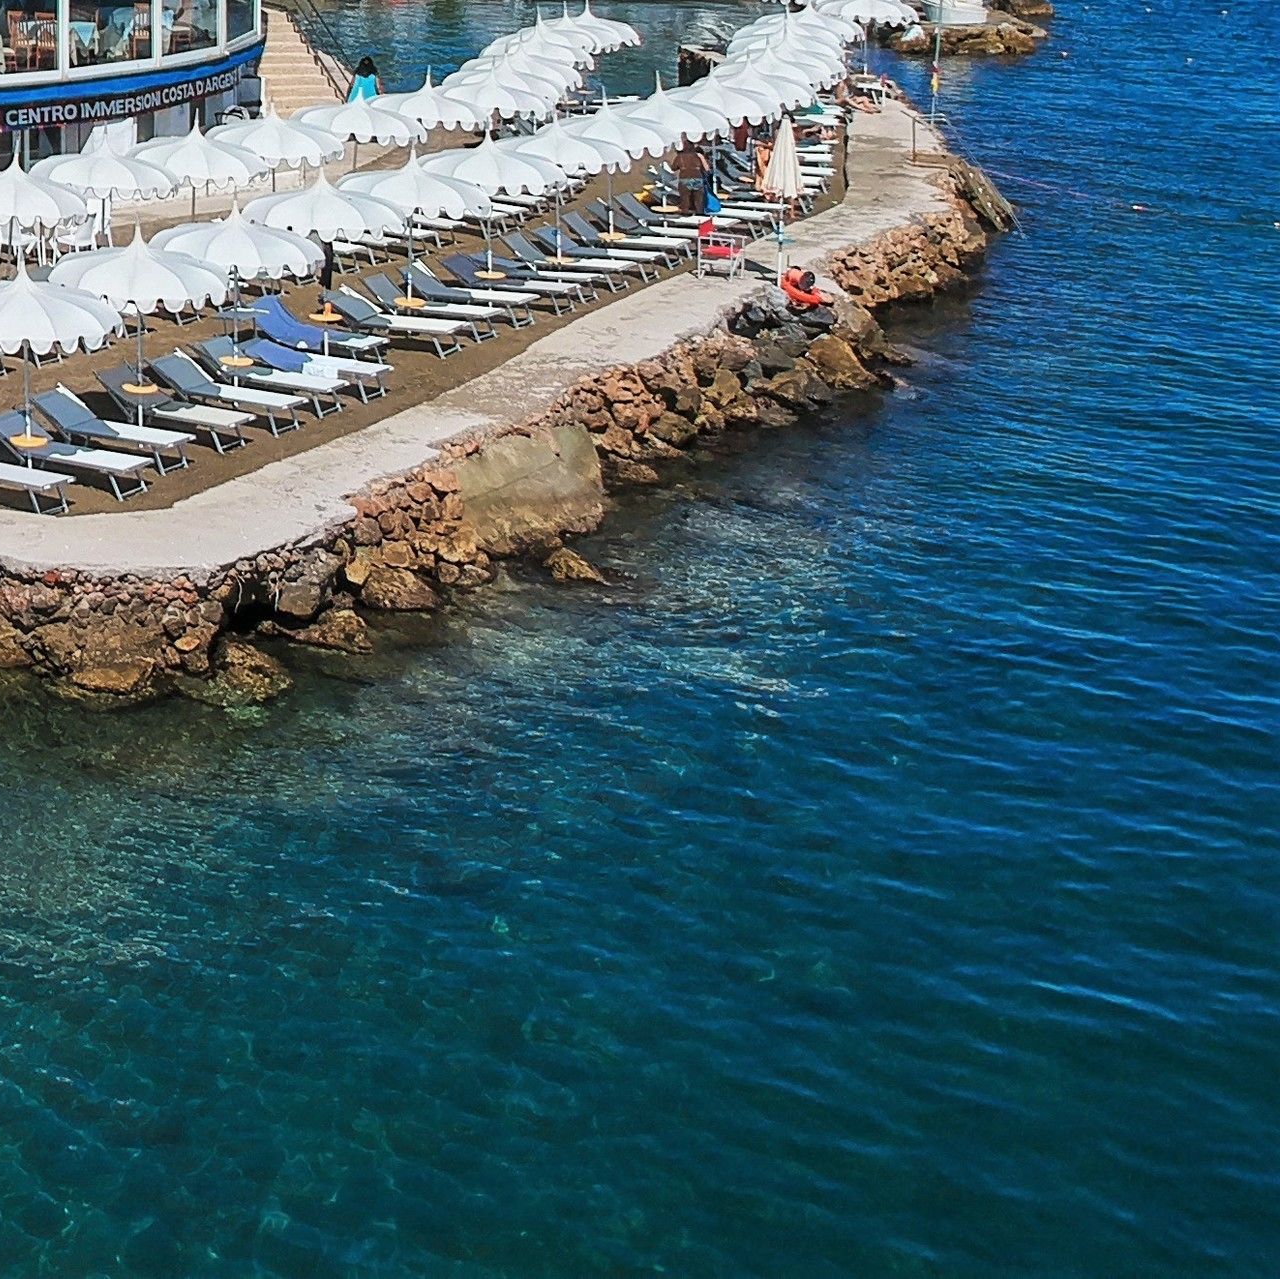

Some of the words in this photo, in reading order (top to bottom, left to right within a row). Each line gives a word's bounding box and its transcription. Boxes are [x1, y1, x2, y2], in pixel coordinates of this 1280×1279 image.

[5, 104, 78, 126] CENTRO
[80, 90, 161, 119] IMMERSIONI
[162, 82, 195, 104] COSTA
